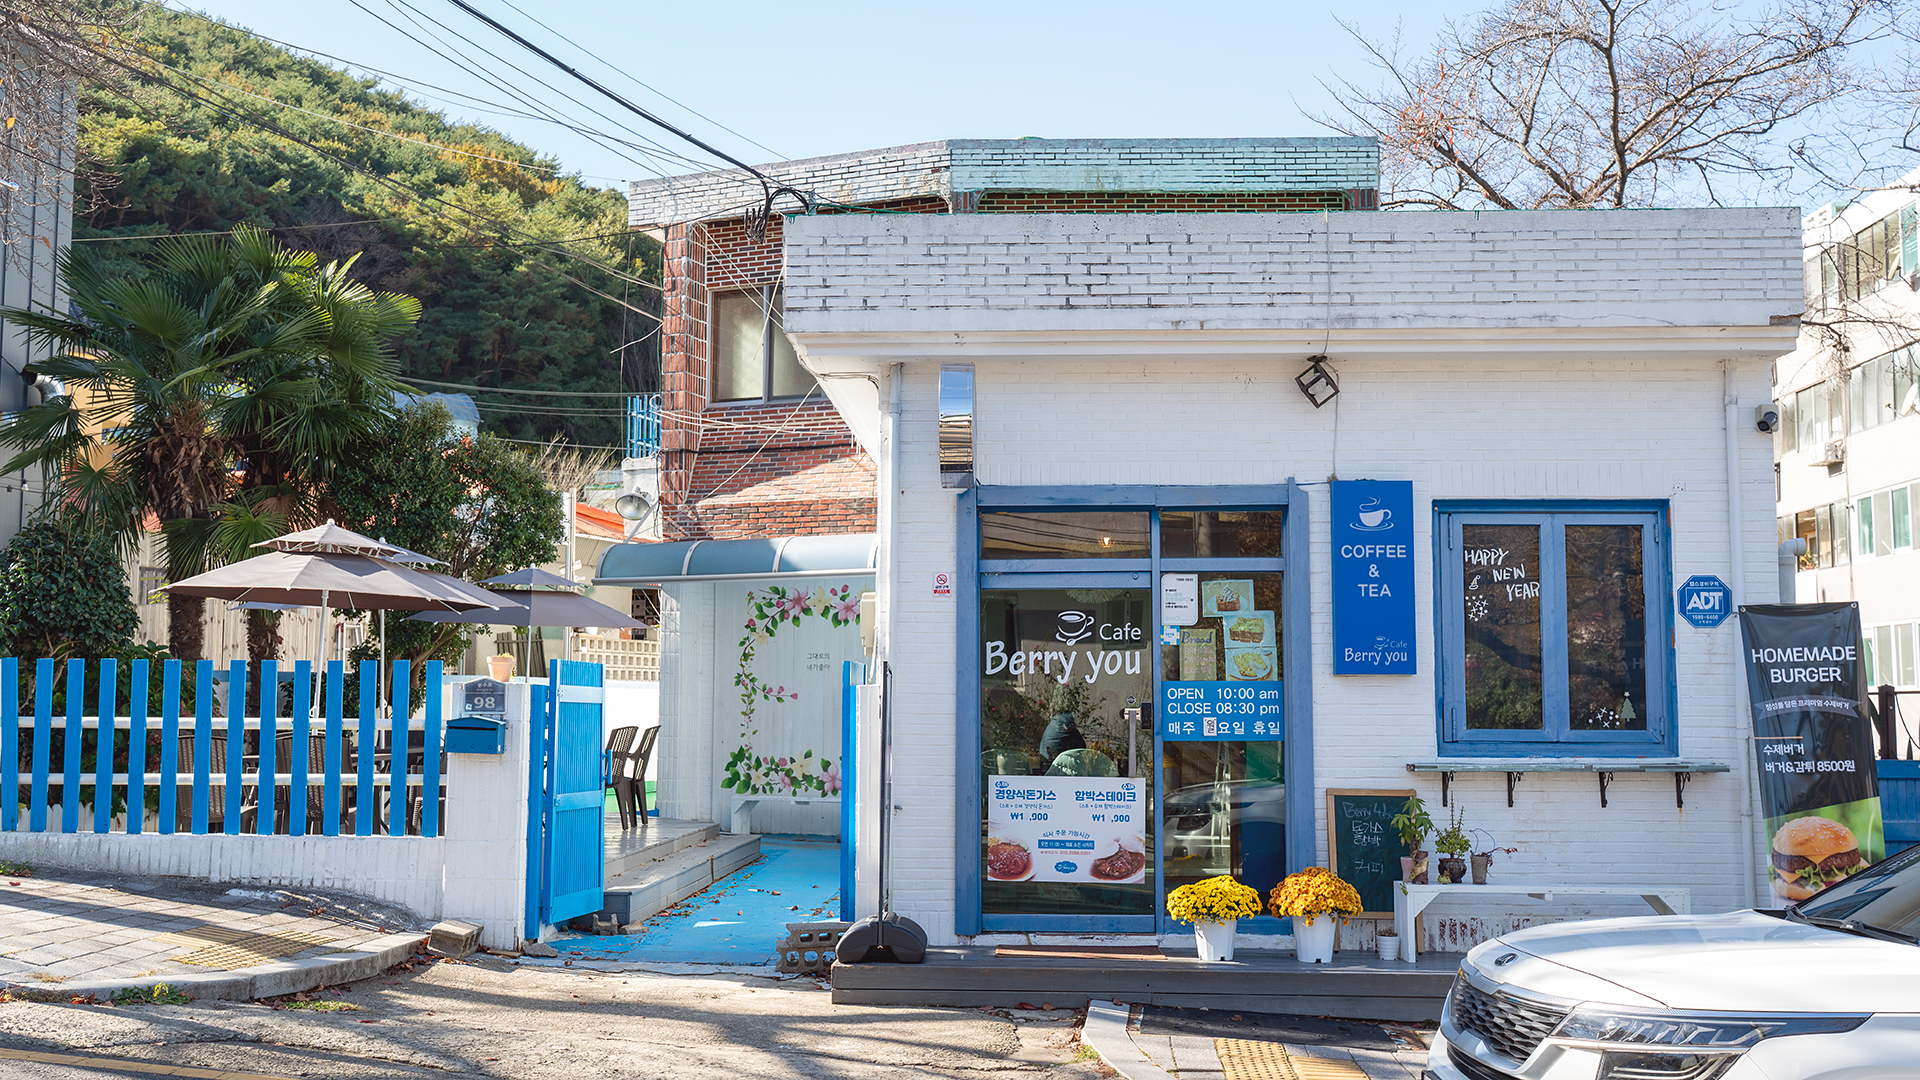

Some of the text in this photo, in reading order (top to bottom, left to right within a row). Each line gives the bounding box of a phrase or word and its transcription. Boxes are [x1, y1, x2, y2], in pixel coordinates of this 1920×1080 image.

[1341, 545, 1406, 558] COFFEE
[1464, 548, 1509, 566] HAPPY
[1368, 564, 1380, 577] &
[1492, 564, 1525, 582] NEW
[1358, 584, 1391, 597] TEA
[1506, 582, 1540, 602] YEAR
[1687, 592, 1723, 610] ADT
[1099, 622, 1142, 640] Cafe
[1181, 630, 1213, 644] Bread
[1390, 640, 1408, 648] Cafe
[1344, 648, 1408, 665] Berry you
[1752, 646, 1857, 663] HOMEMADE
[986, 640, 1140, 684] Berry you
[1770, 667, 1842, 683] BURGER
[1167, 688, 1278, 699] OPEN 10:00 am
[474, 697, 495, 708] 98
[1784, 700, 1797, 708] 담은
[1824, 700, 1849, 709] 수제버거
[1167, 703, 1279, 716] CLOSE 08:30 pm
[1168, 721, 1195, 735] 매주
[1253, 721, 1280, 735] 휴일
[1763, 743, 1805, 755] 수제버거
[1765, 760, 1856, 773] 버거&감튀 8500원
[995, 789, 1056, 800] 경양식돈가스
[1074, 790, 1136, 802] 함박스테이크
[1354, 859, 1384, 874] 커피
